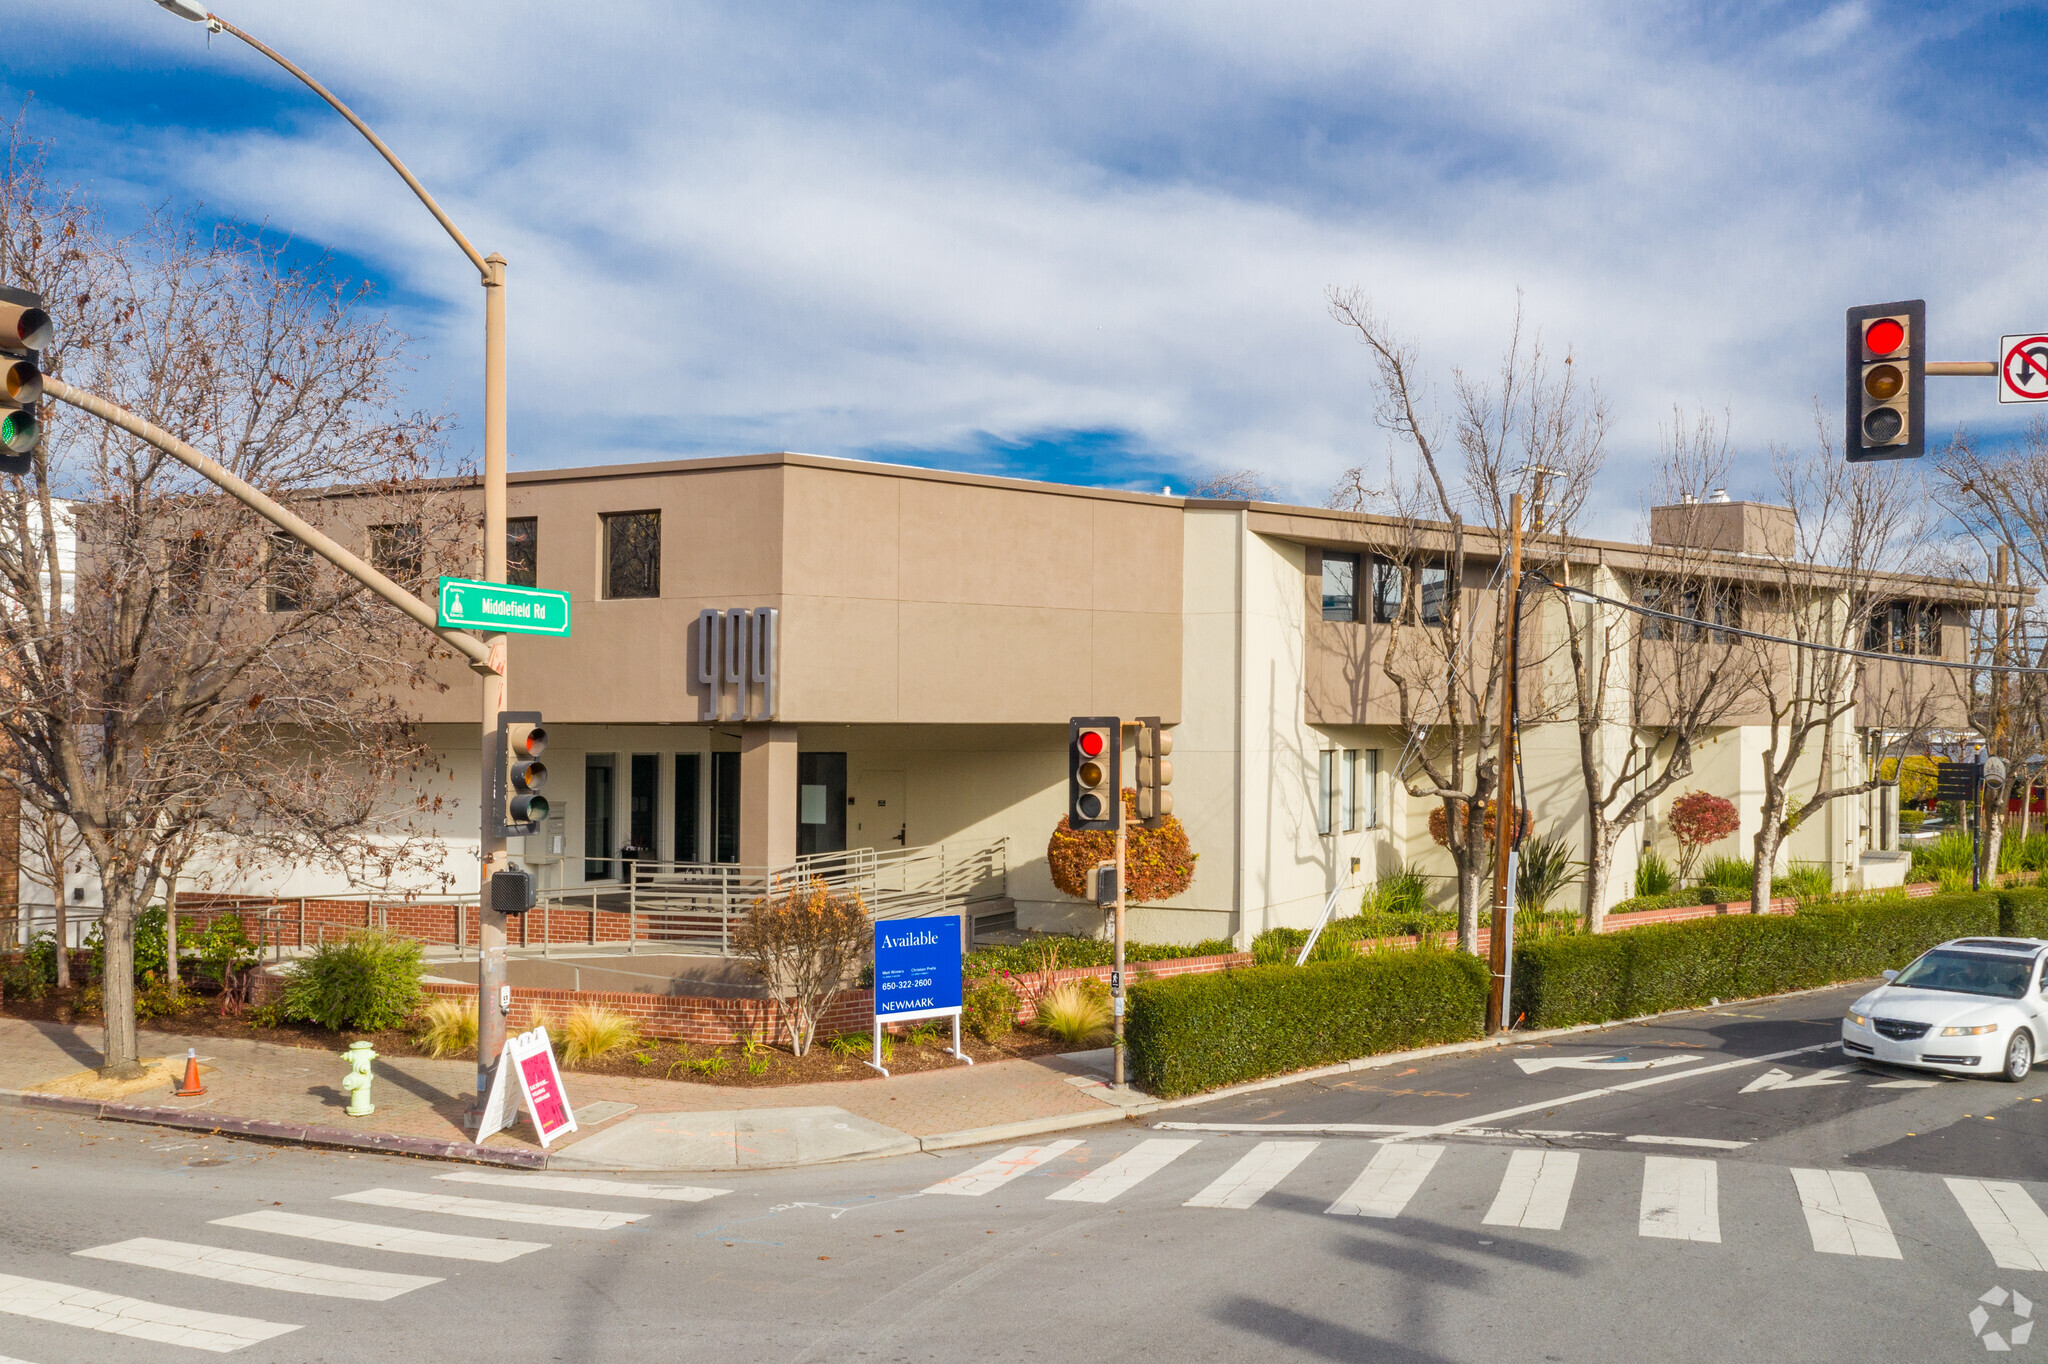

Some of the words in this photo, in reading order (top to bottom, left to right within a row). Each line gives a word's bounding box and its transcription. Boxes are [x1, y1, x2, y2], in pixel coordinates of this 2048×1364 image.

[481, 597, 531, 618] Middlefield
[533, 603, 546, 619] Rd
[699, 606, 778, 722] 999
[881, 930, 939, 949] Available
[882, 978, 932, 990] 650-322-2600
[882, 997, 934, 1011] NEWMARK
